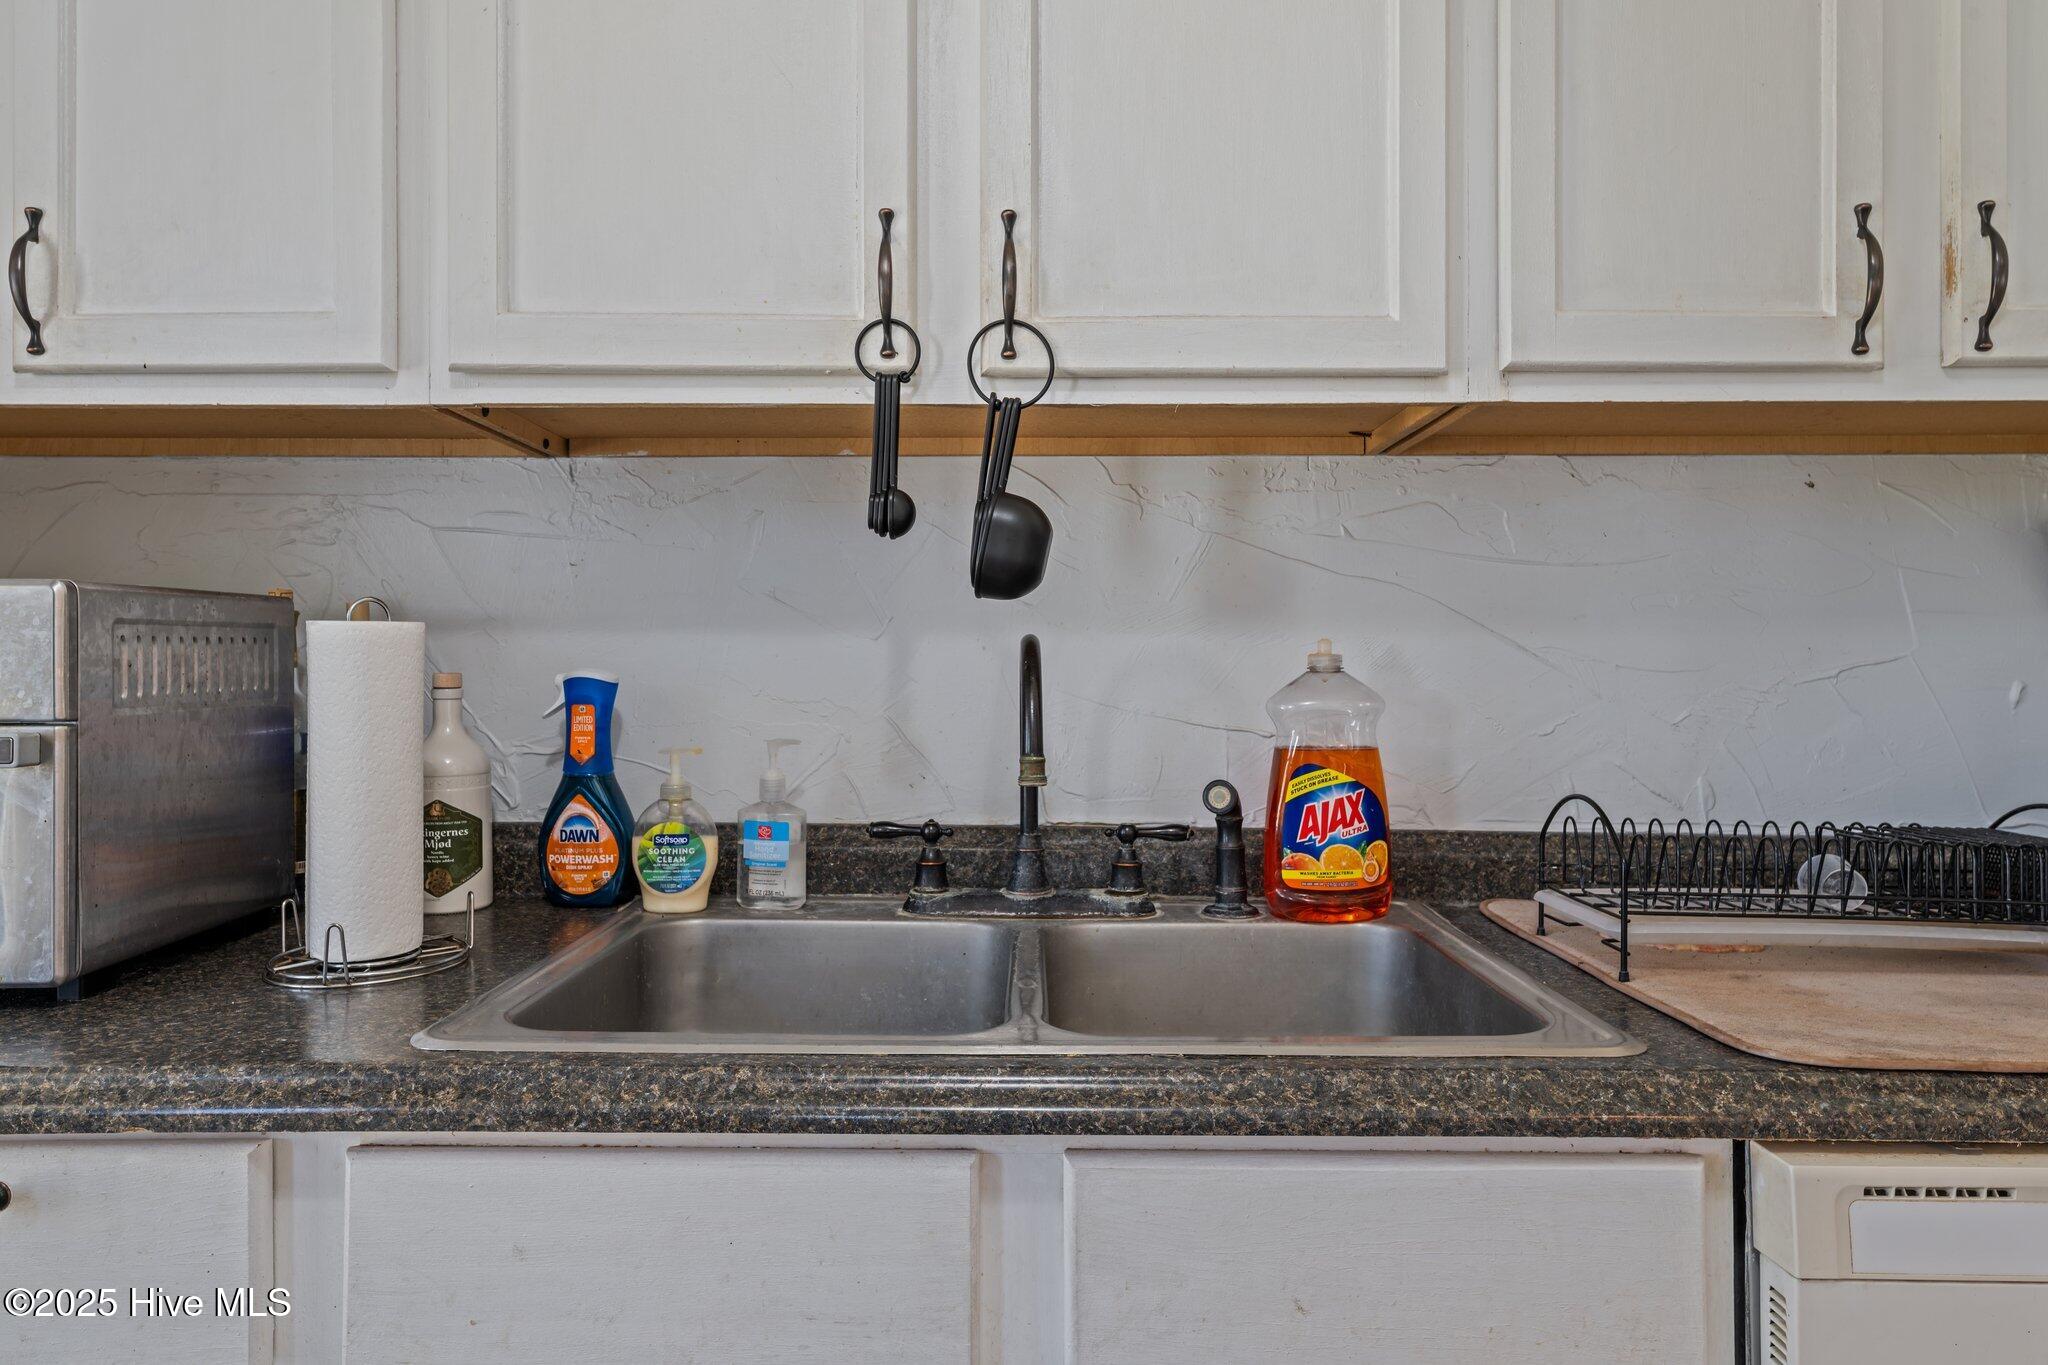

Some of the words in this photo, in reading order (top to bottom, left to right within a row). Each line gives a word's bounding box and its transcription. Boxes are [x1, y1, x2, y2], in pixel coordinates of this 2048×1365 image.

[574, 716, 593, 724] LIMITED
[574, 724, 593, 732] EDITION
[1290, 784, 1308, 795] STUCK
[1317, 775, 1338, 784] GREASE
[1292, 779, 1306, 788] EASILY
[1307, 772, 1332, 782] DISSOLVES
[1297, 788, 1366, 846] AJAX
[560, 829, 600, 842] DAWN
[1342, 825, 1368, 838] ULTRA
[424, 839, 452, 850] Mjød
[655, 835, 688, 845] Softsoap
[550, 854, 614, 864] POWERWASH
